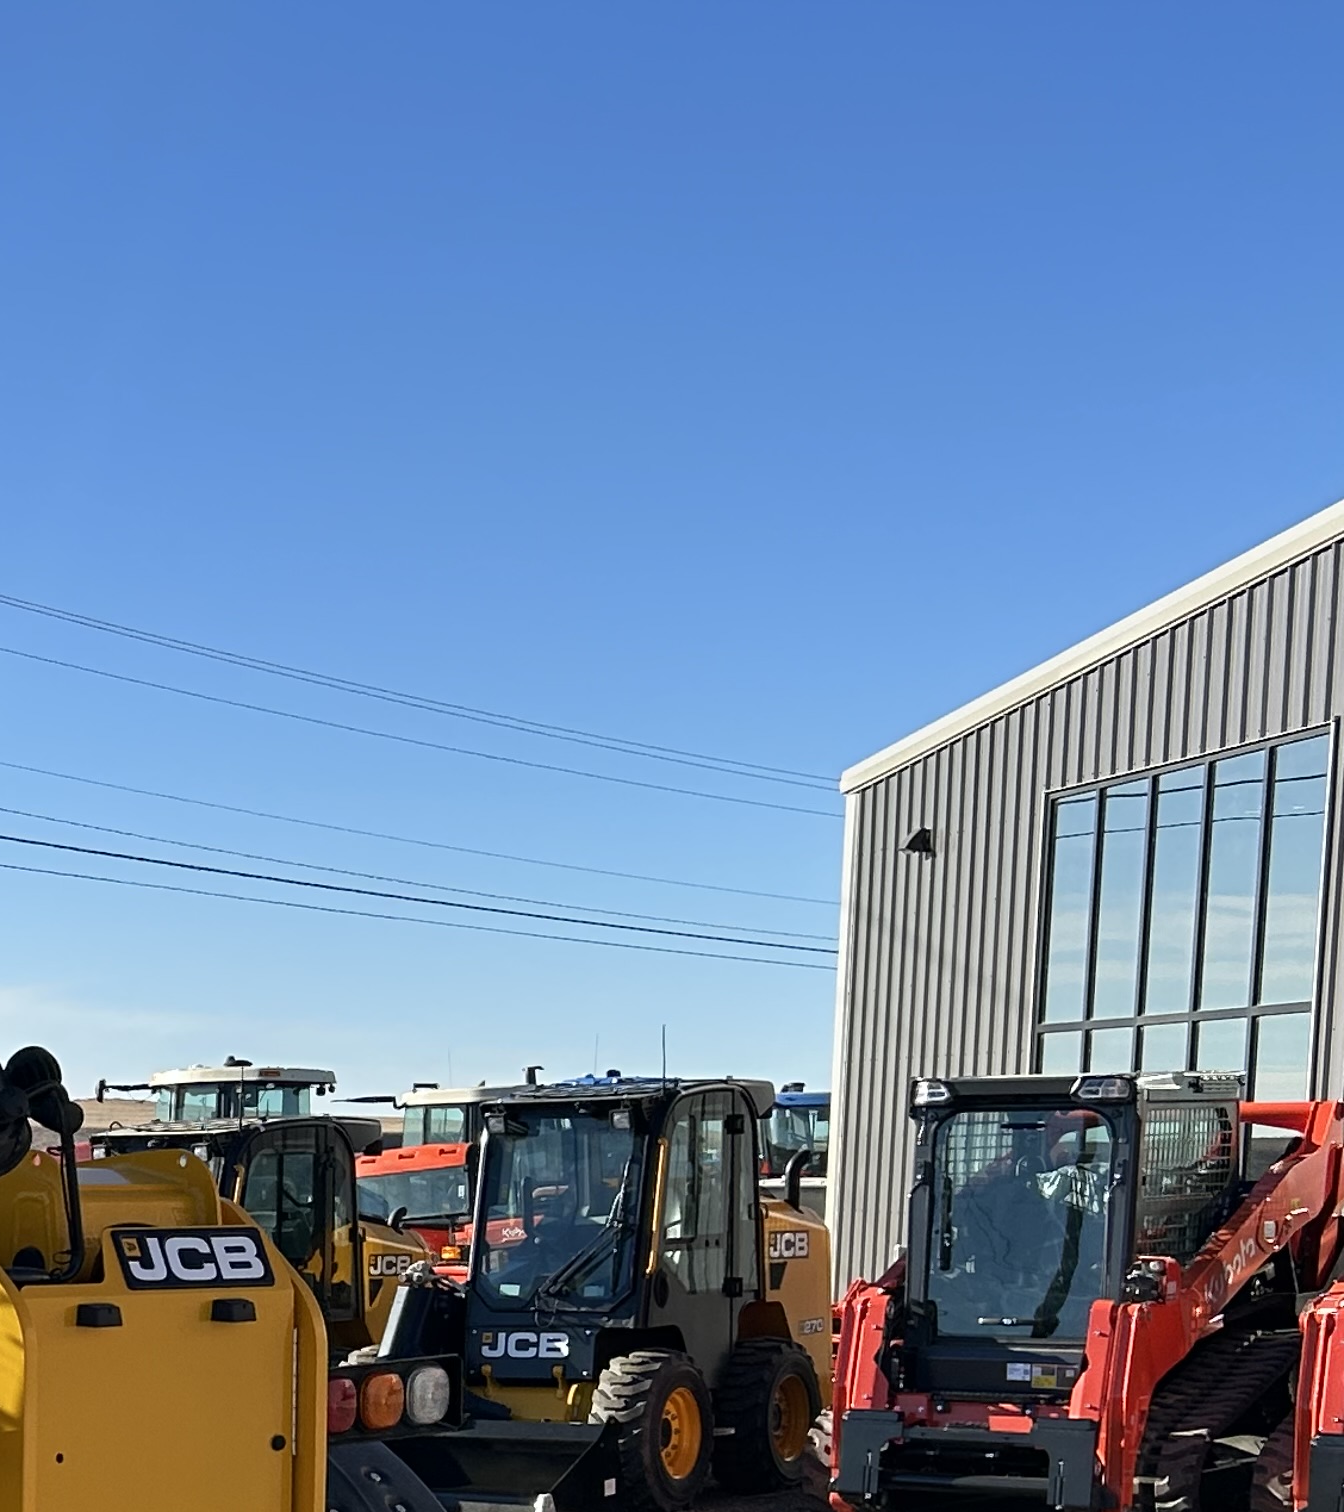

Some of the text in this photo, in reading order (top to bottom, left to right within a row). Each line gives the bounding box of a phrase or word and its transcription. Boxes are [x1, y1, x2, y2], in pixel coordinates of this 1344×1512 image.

[770, 1232, 809, 1258] JCB
[127, 1236, 265, 1281] JCB
[369, 1255, 411, 1277] JCB
[803, 1318, 824, 1334] 270
[481, 1332, 570, 1359] JCB
